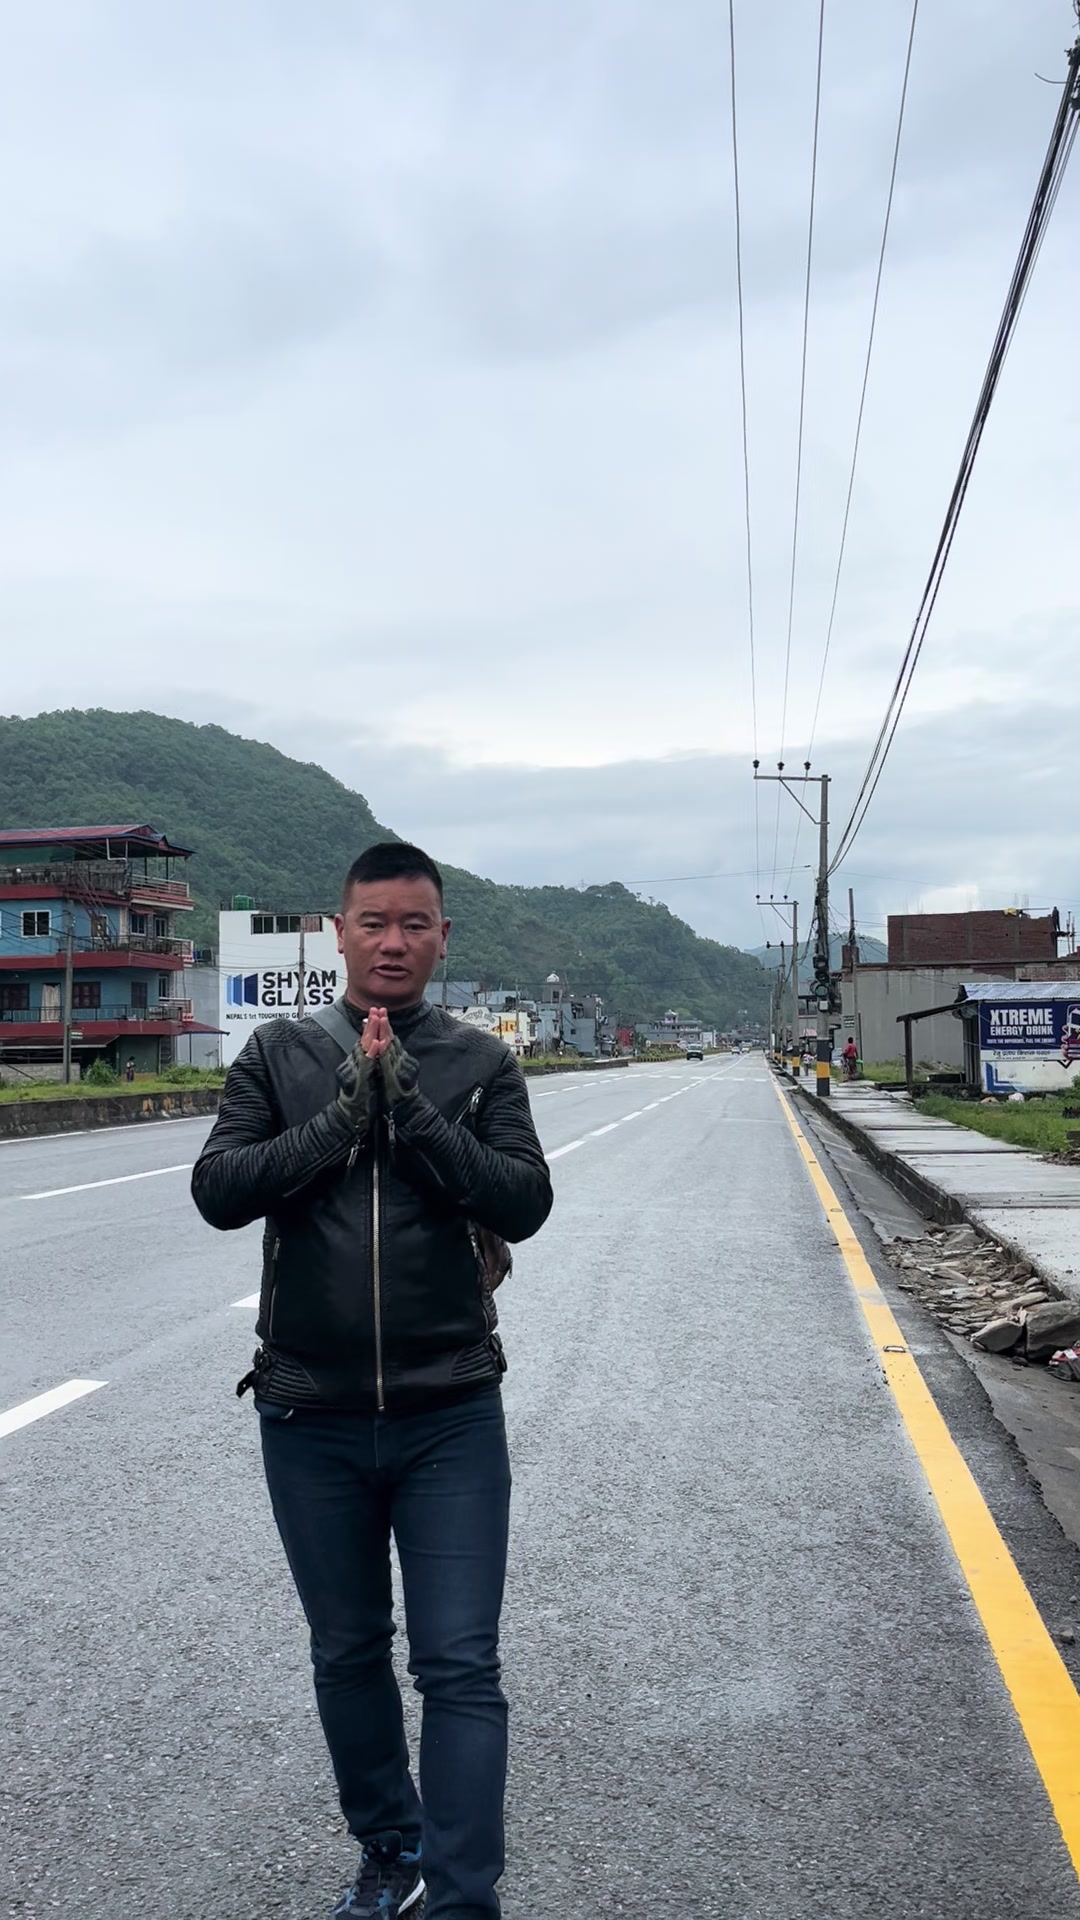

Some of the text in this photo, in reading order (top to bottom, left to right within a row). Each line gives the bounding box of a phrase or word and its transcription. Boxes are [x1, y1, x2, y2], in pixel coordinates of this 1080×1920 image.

[262, 970, 336, 989] SHYAM
[261, 988, 334, 1007] GLASS
[990, 1008, 1054, 1026] XTREME
[990, 1025, 1054, 1036] ENERGY DRINK
